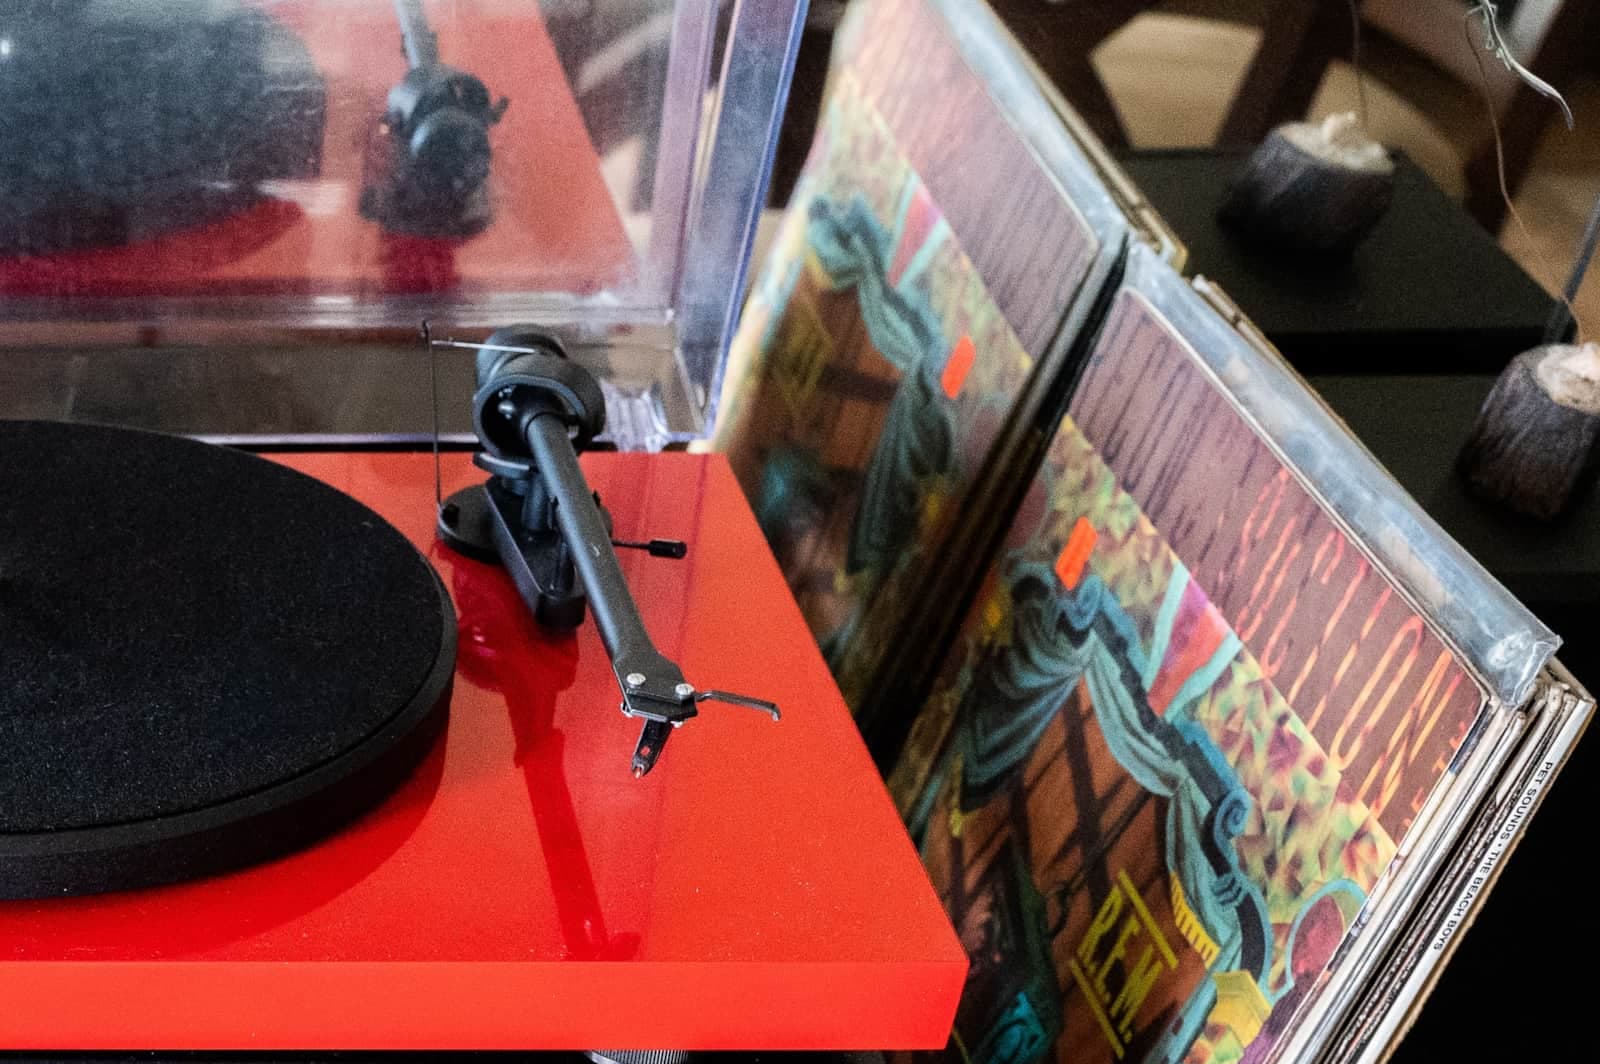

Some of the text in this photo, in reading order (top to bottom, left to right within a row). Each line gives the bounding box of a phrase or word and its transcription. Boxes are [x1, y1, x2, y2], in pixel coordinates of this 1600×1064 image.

[1432, 760, 1553, 951] PET SOUNDS THE BEACH BOYS
